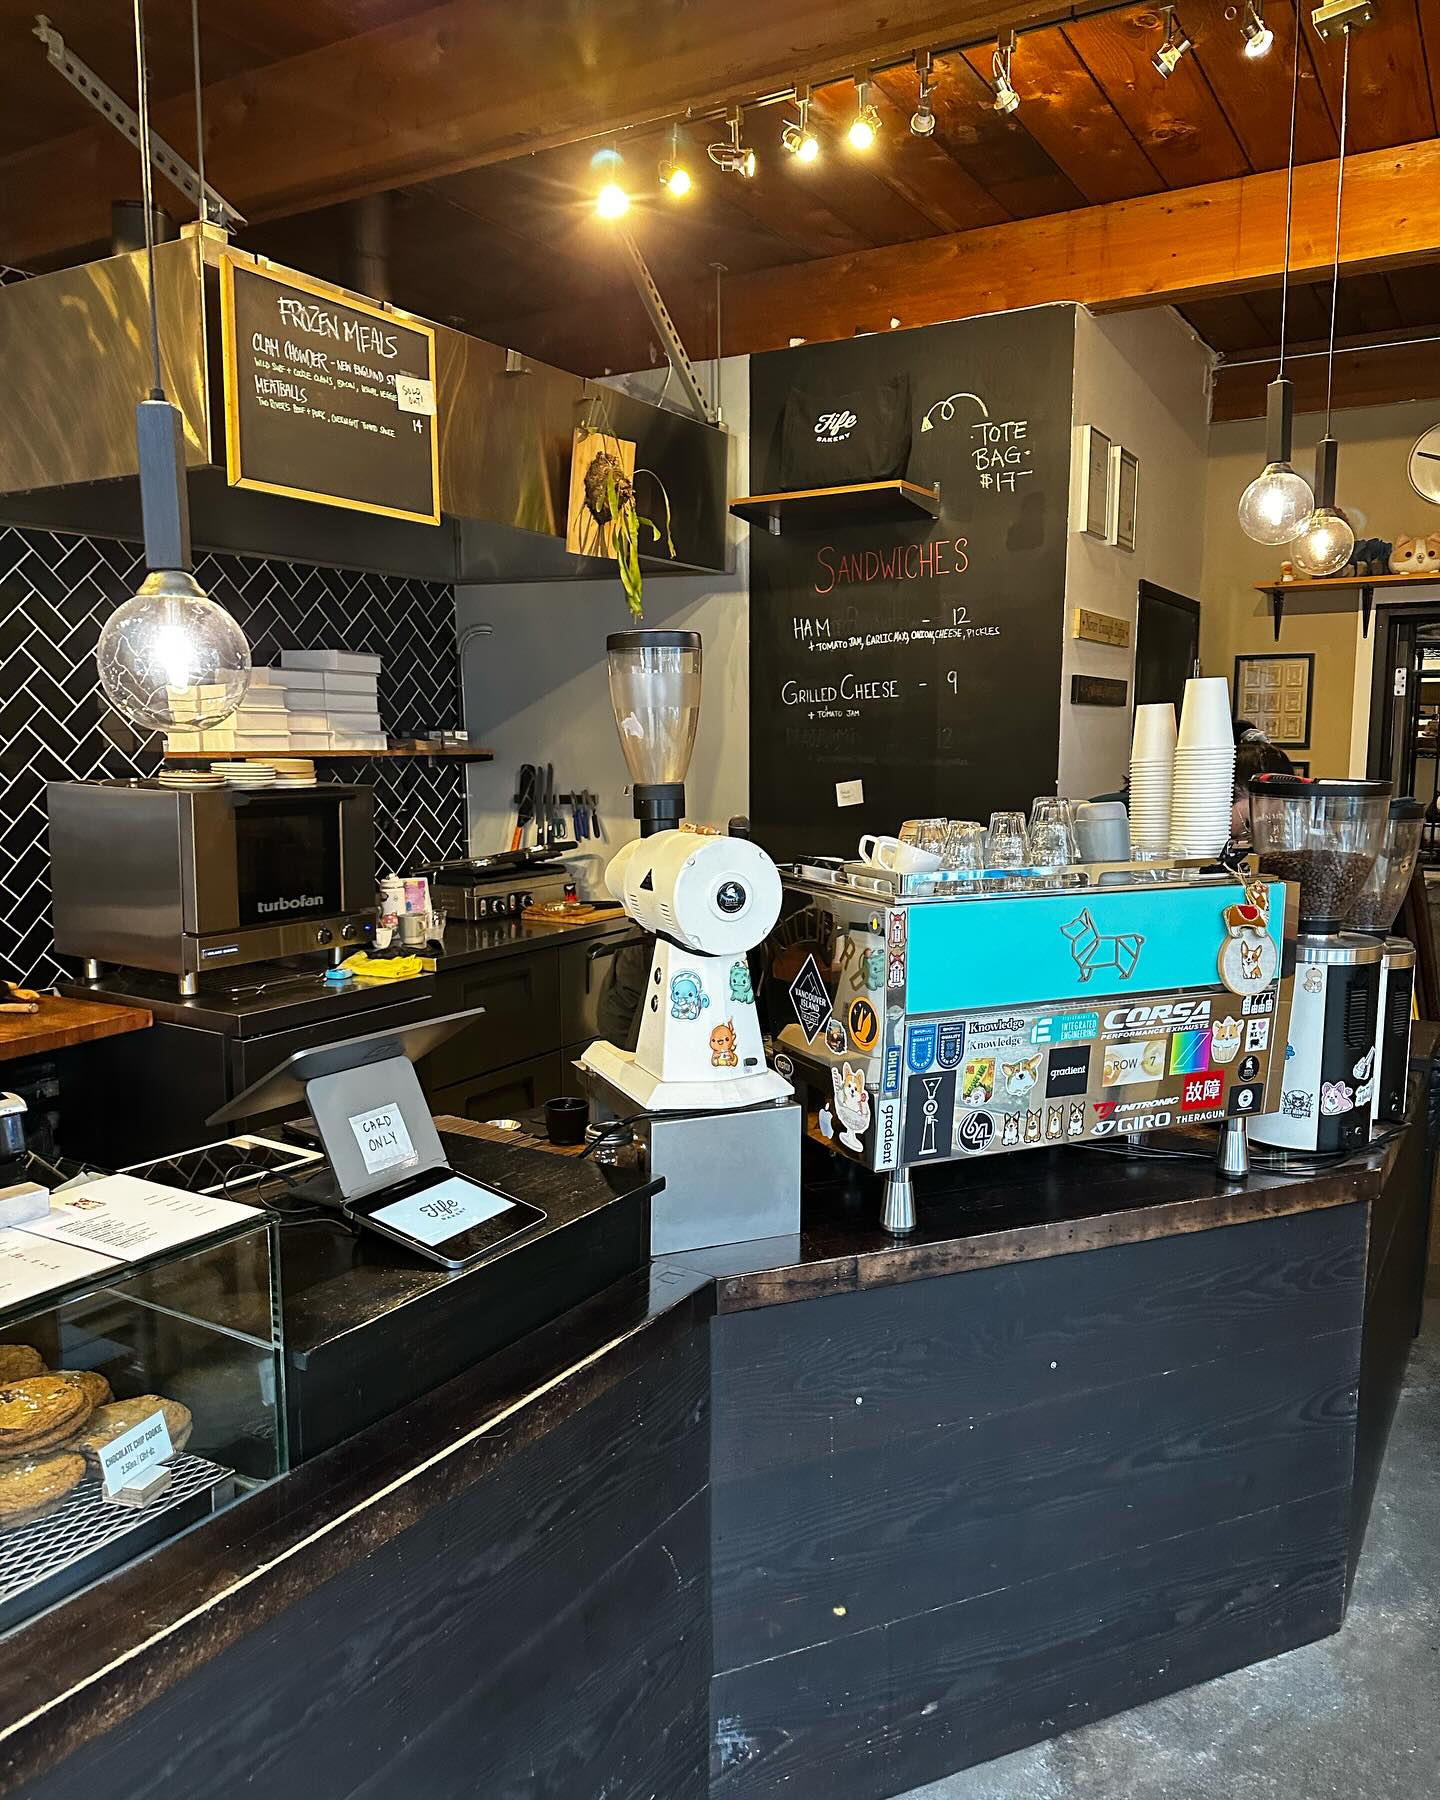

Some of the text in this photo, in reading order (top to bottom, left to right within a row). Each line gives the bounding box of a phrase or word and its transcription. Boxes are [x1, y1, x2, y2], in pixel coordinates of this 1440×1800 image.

[277, 296, 398, 358] FROZEN MEALS
[252, 332, 280, 358] CLAM
[284, 340, 330, 373] CHOWDER
[254, 374, 308, 404] MEATBALLS
[412, 419, 423, 434] 14
[814, 410, 858, 436] Fife
[816, 432, 851, 443] BAKERY
[814, 537, 969, 594] SANDWICHES
[793, 617, 831, 641] HAM
[952, 606, 971, 626] 12
[865, 632, 893, 646] GARLIC
[966, 626, 1000, 638] PICKLES
[781, 680, 837, 705] GRILLED
[840, 673, 900, 700] CHEESE
[947, 670, 958, 694] 9
[816, 709, 843, 719] TOMATO
[846, 709, 860, 718] JAM
[257, 894, 324, 913] turbofan
[795, 987, 827, 1008] VANCOUVER
[801, 999, 820, 1012] ISLAND
[1103, 1000, 1212, 1030] CORSA
[968, 1018, 1025, 1035] Knowledge
[1061, 1029, 1096, 1040] ENGINEERING
[1062, 1020, 1097, 1031] INTEGRATED
[1101, 1022, 1209, 1041] PERFORMANCE EXHAUSTS
[967, 1036, 1023, 1051] Knowledge
[1050, 1065, 1086, 1080] gradient
[1113, 1056, 1156, 1071] ROW 7
[1185, 1078, 1221, 1103] 故障
[1114, 1096, 1180, 1113] UNITRONIC
[362, 1115, 392, 1133] CARD
[1117, 1112, 1171, 1133] GIRO
[1175, 1110, 1225, 1124] THERAGUN
[368, 1131, 398, 1152] ONLY
[881, 1104, 895, 1164] gradient
[419, 1199, 458, 1218] Fife
[105, 1424, 163, 1468] CHOCOLATE CHIP COOKIE
